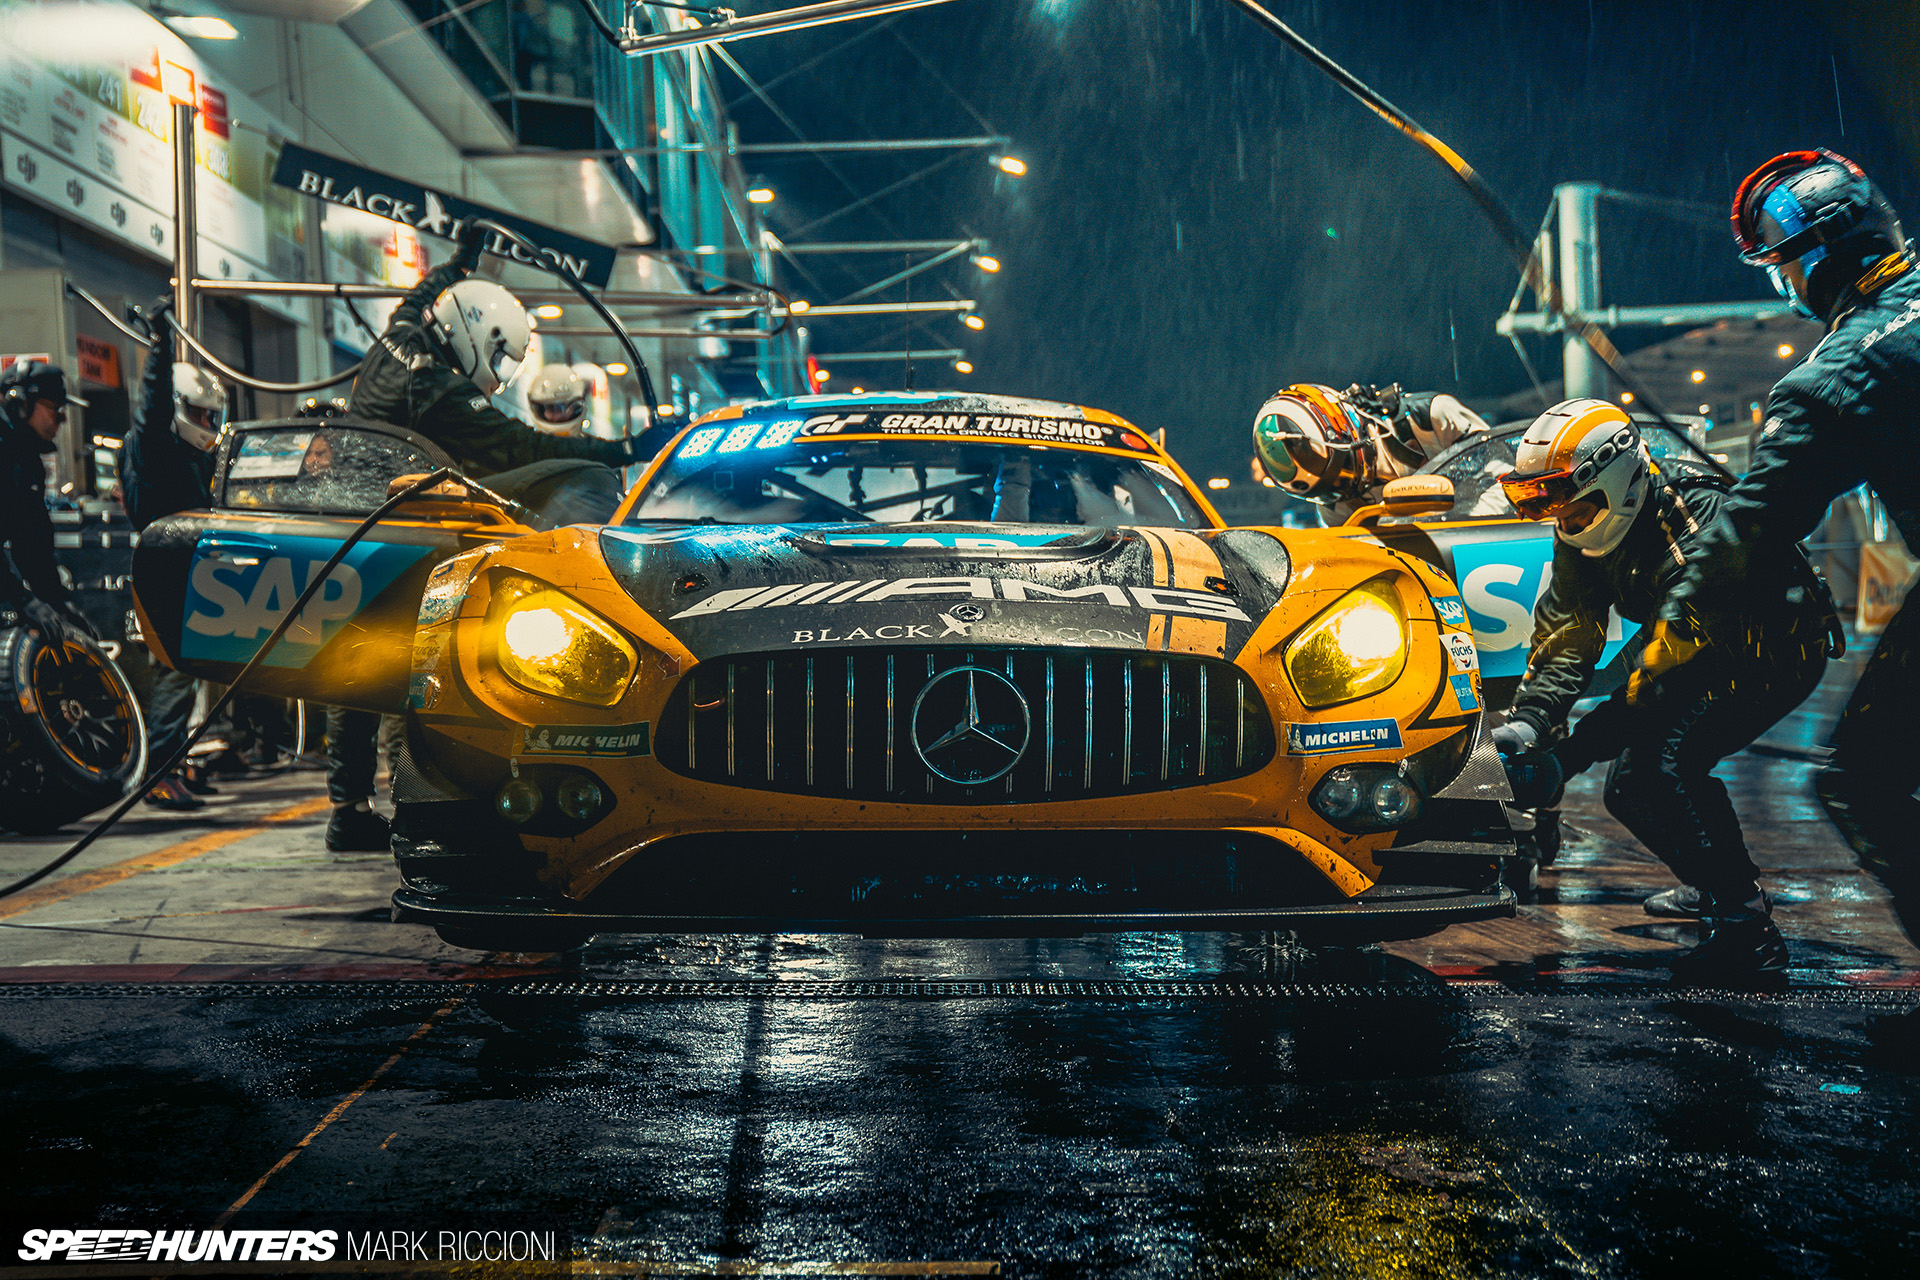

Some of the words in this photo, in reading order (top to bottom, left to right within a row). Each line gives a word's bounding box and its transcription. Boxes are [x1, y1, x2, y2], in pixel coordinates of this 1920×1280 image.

[297, 169, 417, 226] BLACK
[449, 218, 589, 280] FLCON
[881, 414, 971, 430] GRAN
[186, 555, 363, 645] SAP
[857, 577, 1253, 623] AMG
[1434, 600, 1464, 620] SAP
[791, 624, 933, 643] BLACK
[1450, 645, 1473, 657] FUCHS
[553, 732, 641, 750] MICHELIN
[1305, 727, 1389, 746] MICHELIN
